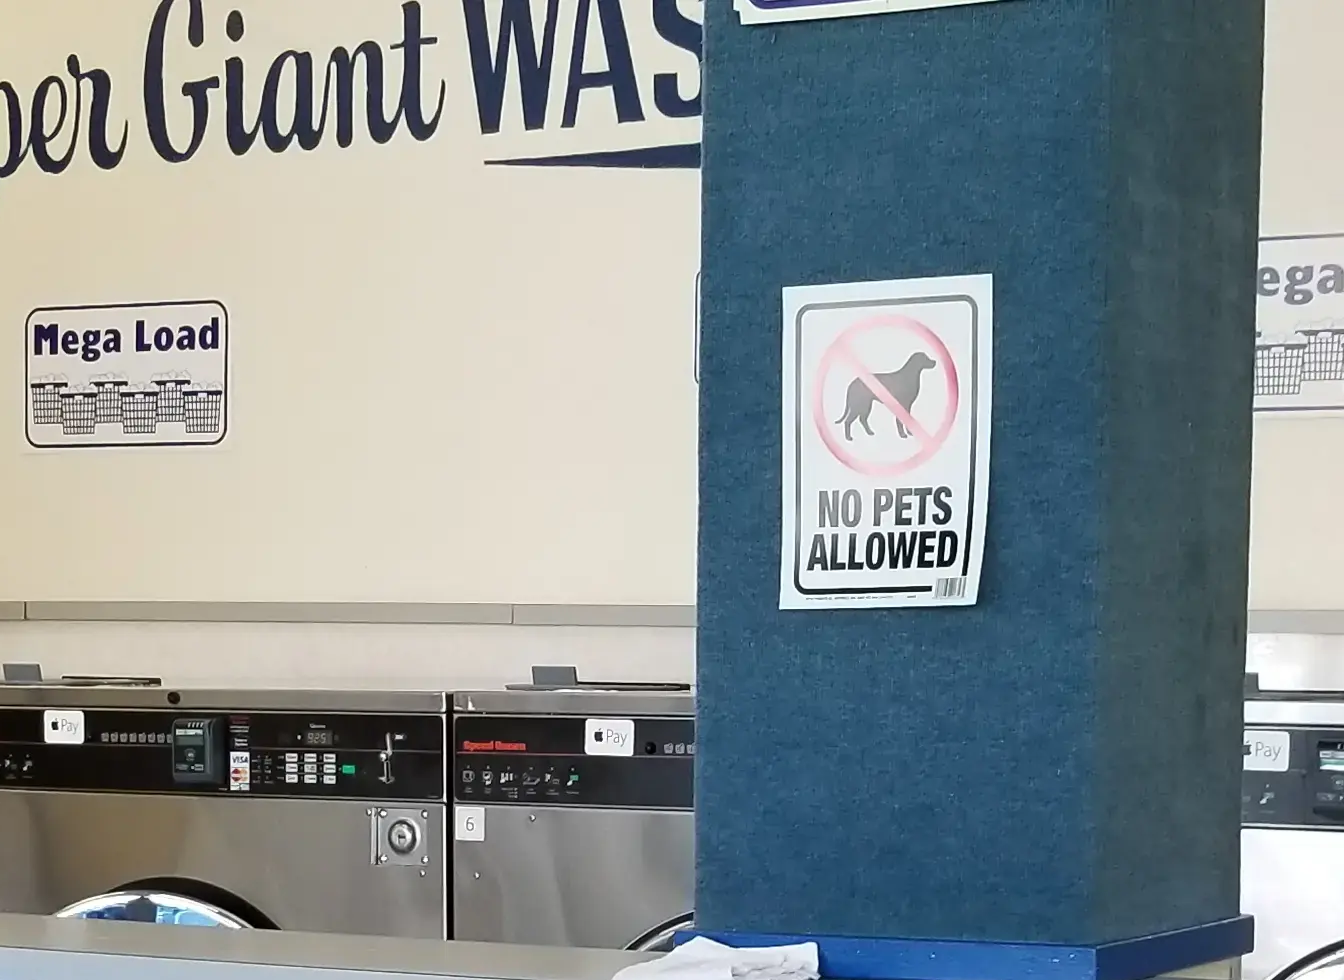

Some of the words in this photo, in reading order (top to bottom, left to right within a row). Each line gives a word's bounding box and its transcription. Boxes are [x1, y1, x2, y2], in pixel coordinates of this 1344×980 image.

[143, 0, 446, 163] Giant
[1257, 263, 1344, 305] ega
[34, 323, 122, 362] Mega
[135, 316, 219, 352] Load
[818, 488, 863, 528] NO
[873, 486, 953, 527] PETS
[806, 530, 959, 571] ALLOWED
[61, 718, 79, 735] Pay
[606, 728, 628, 748] Pay
[232, 755, 249, 764] VISA
[1255, 741, 1282, 761] Pay
[464, 816, 475, 831] 6
